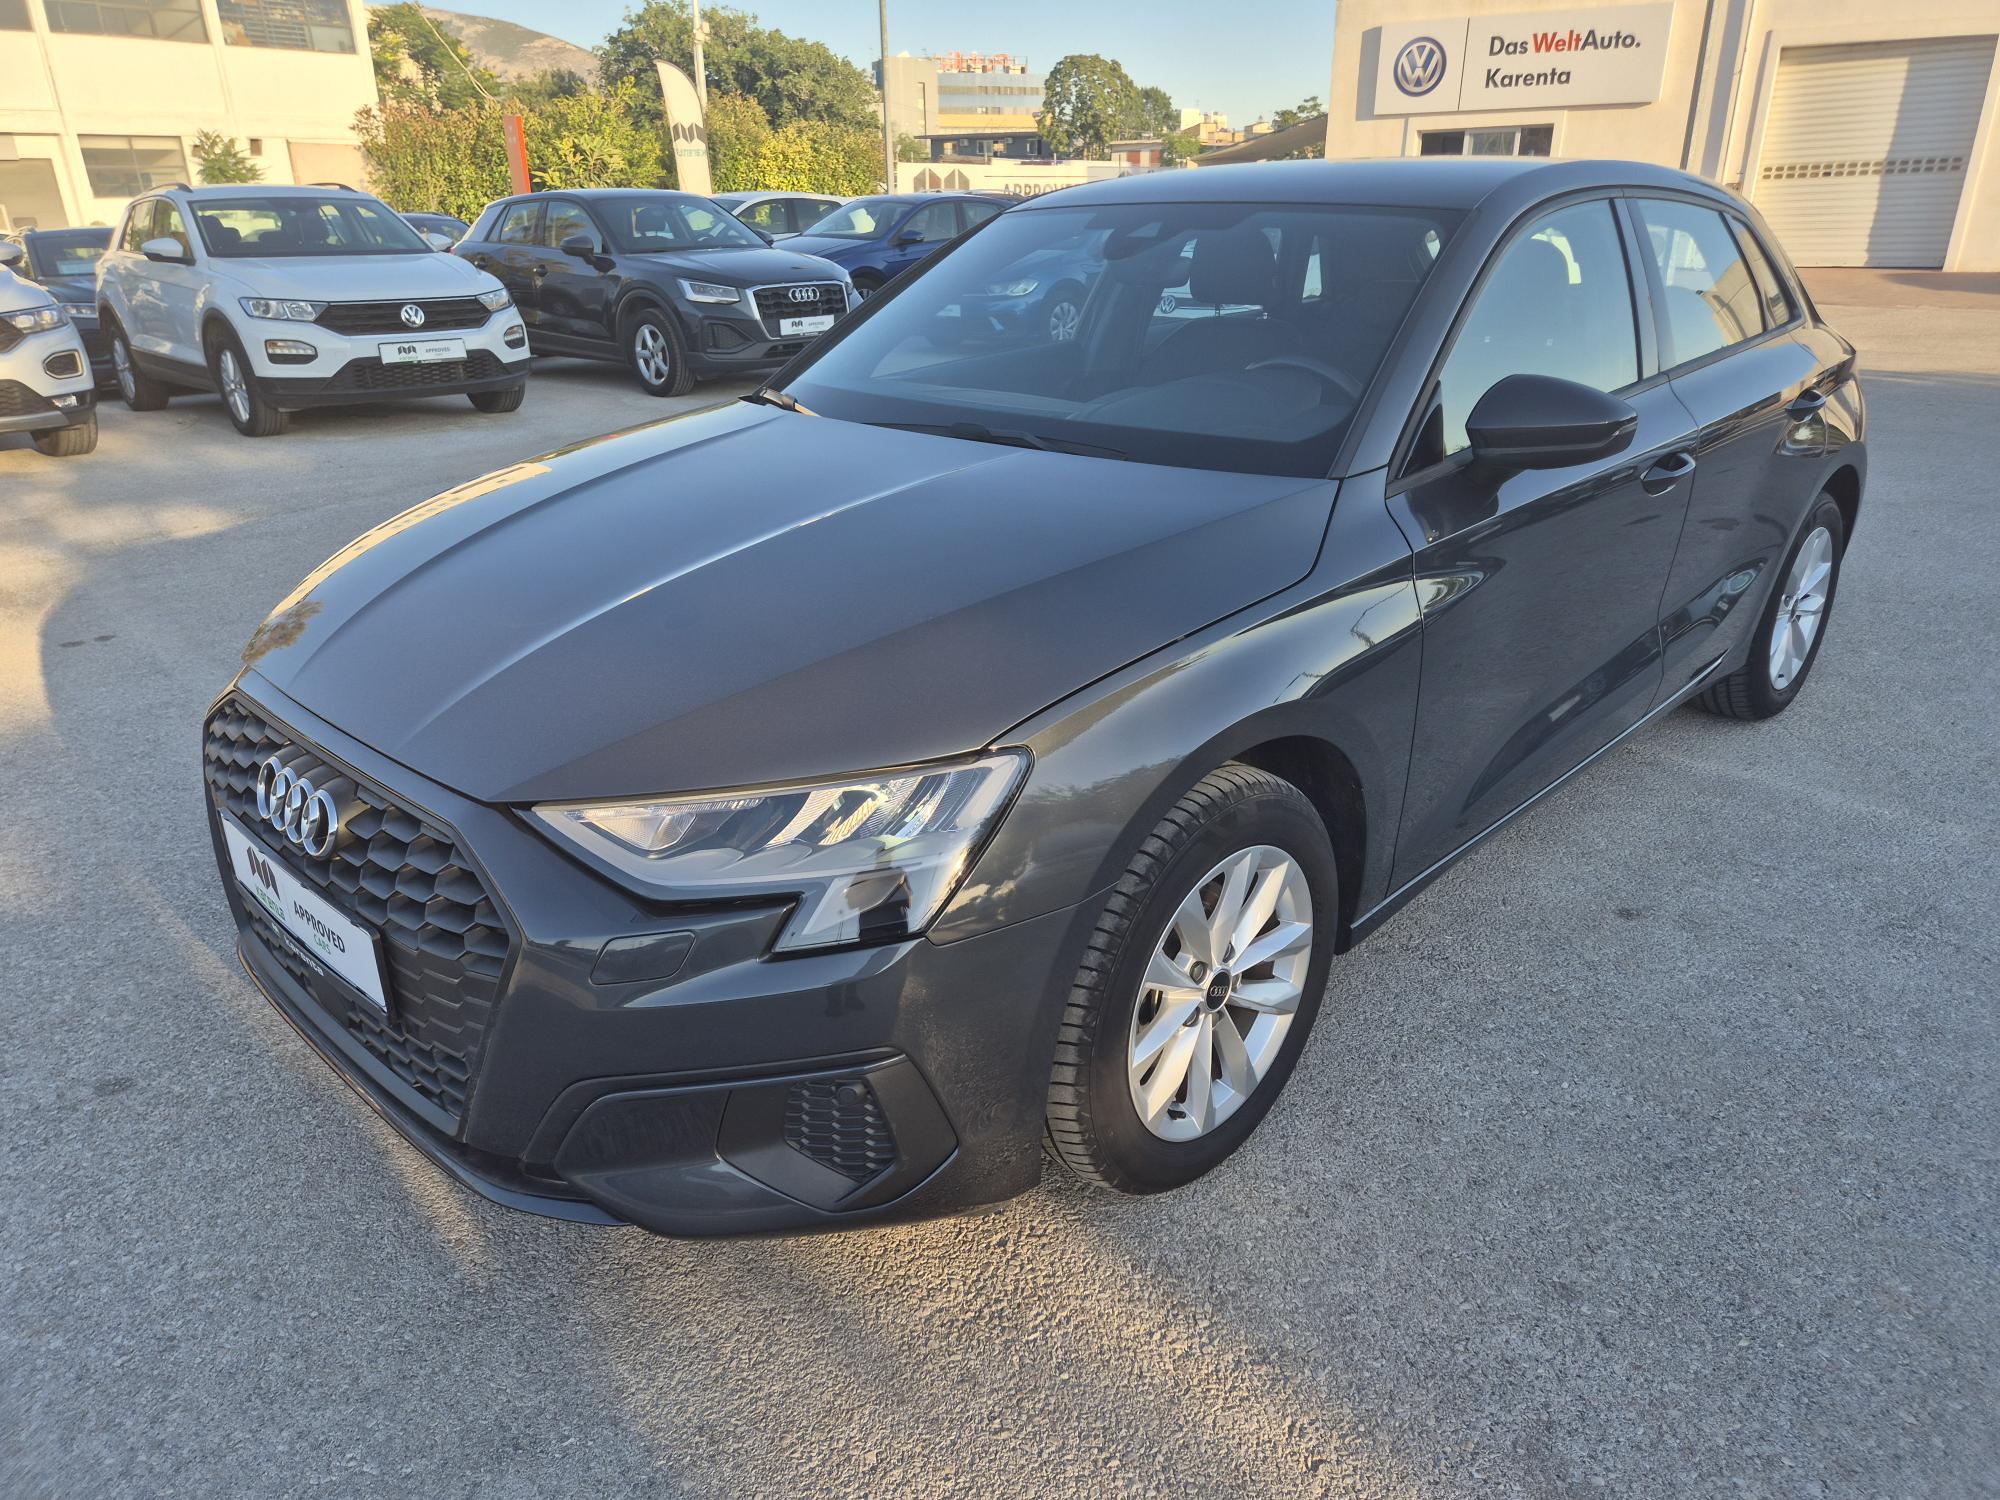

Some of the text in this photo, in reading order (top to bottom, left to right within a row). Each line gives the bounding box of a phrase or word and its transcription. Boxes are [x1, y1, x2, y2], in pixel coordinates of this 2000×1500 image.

[1488, 29, 1641, 57] Das WeltAuto.
[1484, 67, 1572, 89] Karenta
[293, 900, 346, 954] APPROVED
